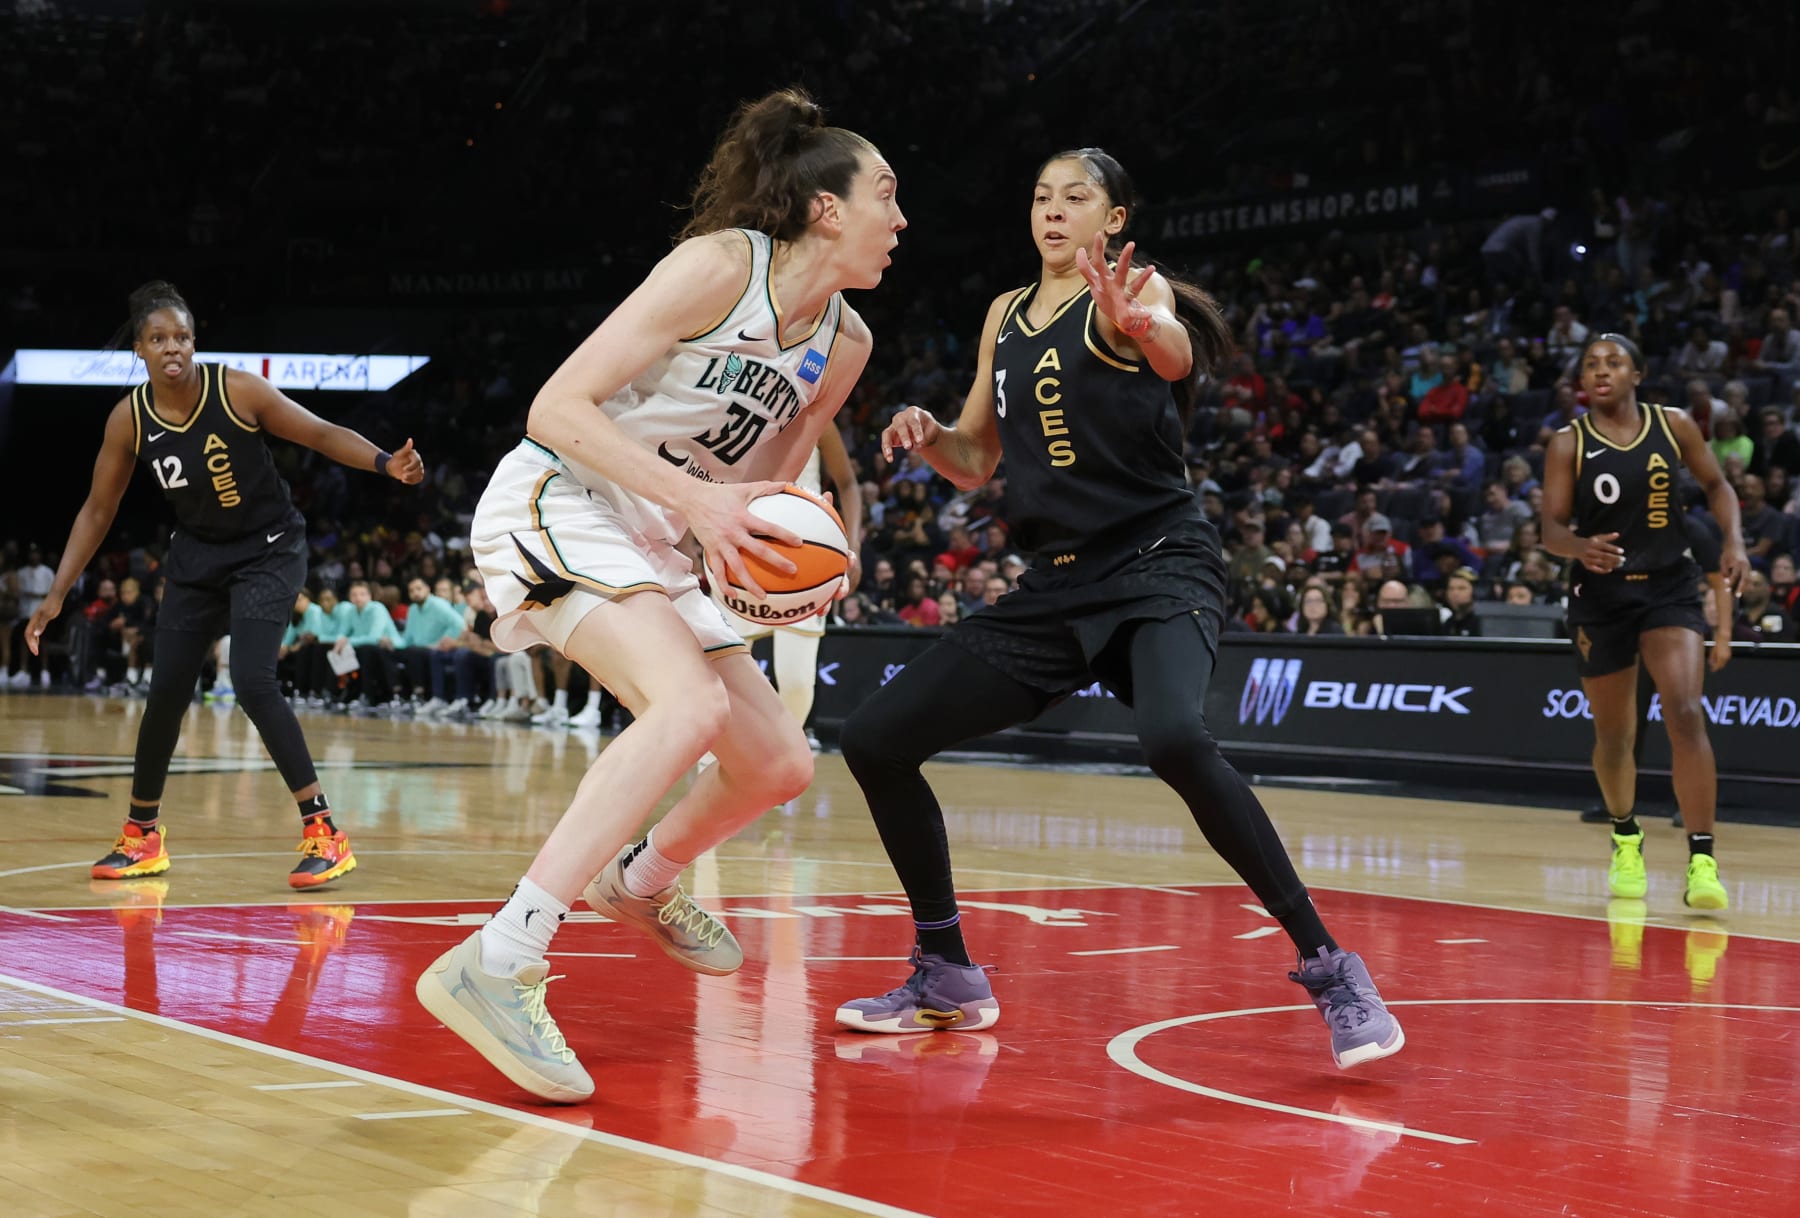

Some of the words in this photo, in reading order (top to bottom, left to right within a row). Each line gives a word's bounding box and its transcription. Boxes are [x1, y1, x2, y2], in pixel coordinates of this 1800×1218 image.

[1161, 184, 1419, 239] ACESTEAMSHOP.COM
[282, 360, 368, 380] ARENA
[803, 359, 821, 375] HSS
[1033, 348, 1077, 467] ACES
[152, 456, 189, 489] 12
[203, 433, 241, 507] ACES
[1593, 473, 1621, 504] 0
[1646, 453, 1670, 528] ACES
[724, 594, 816, 619] Wilson
[1303, 681, 1474, 714] BUICK
